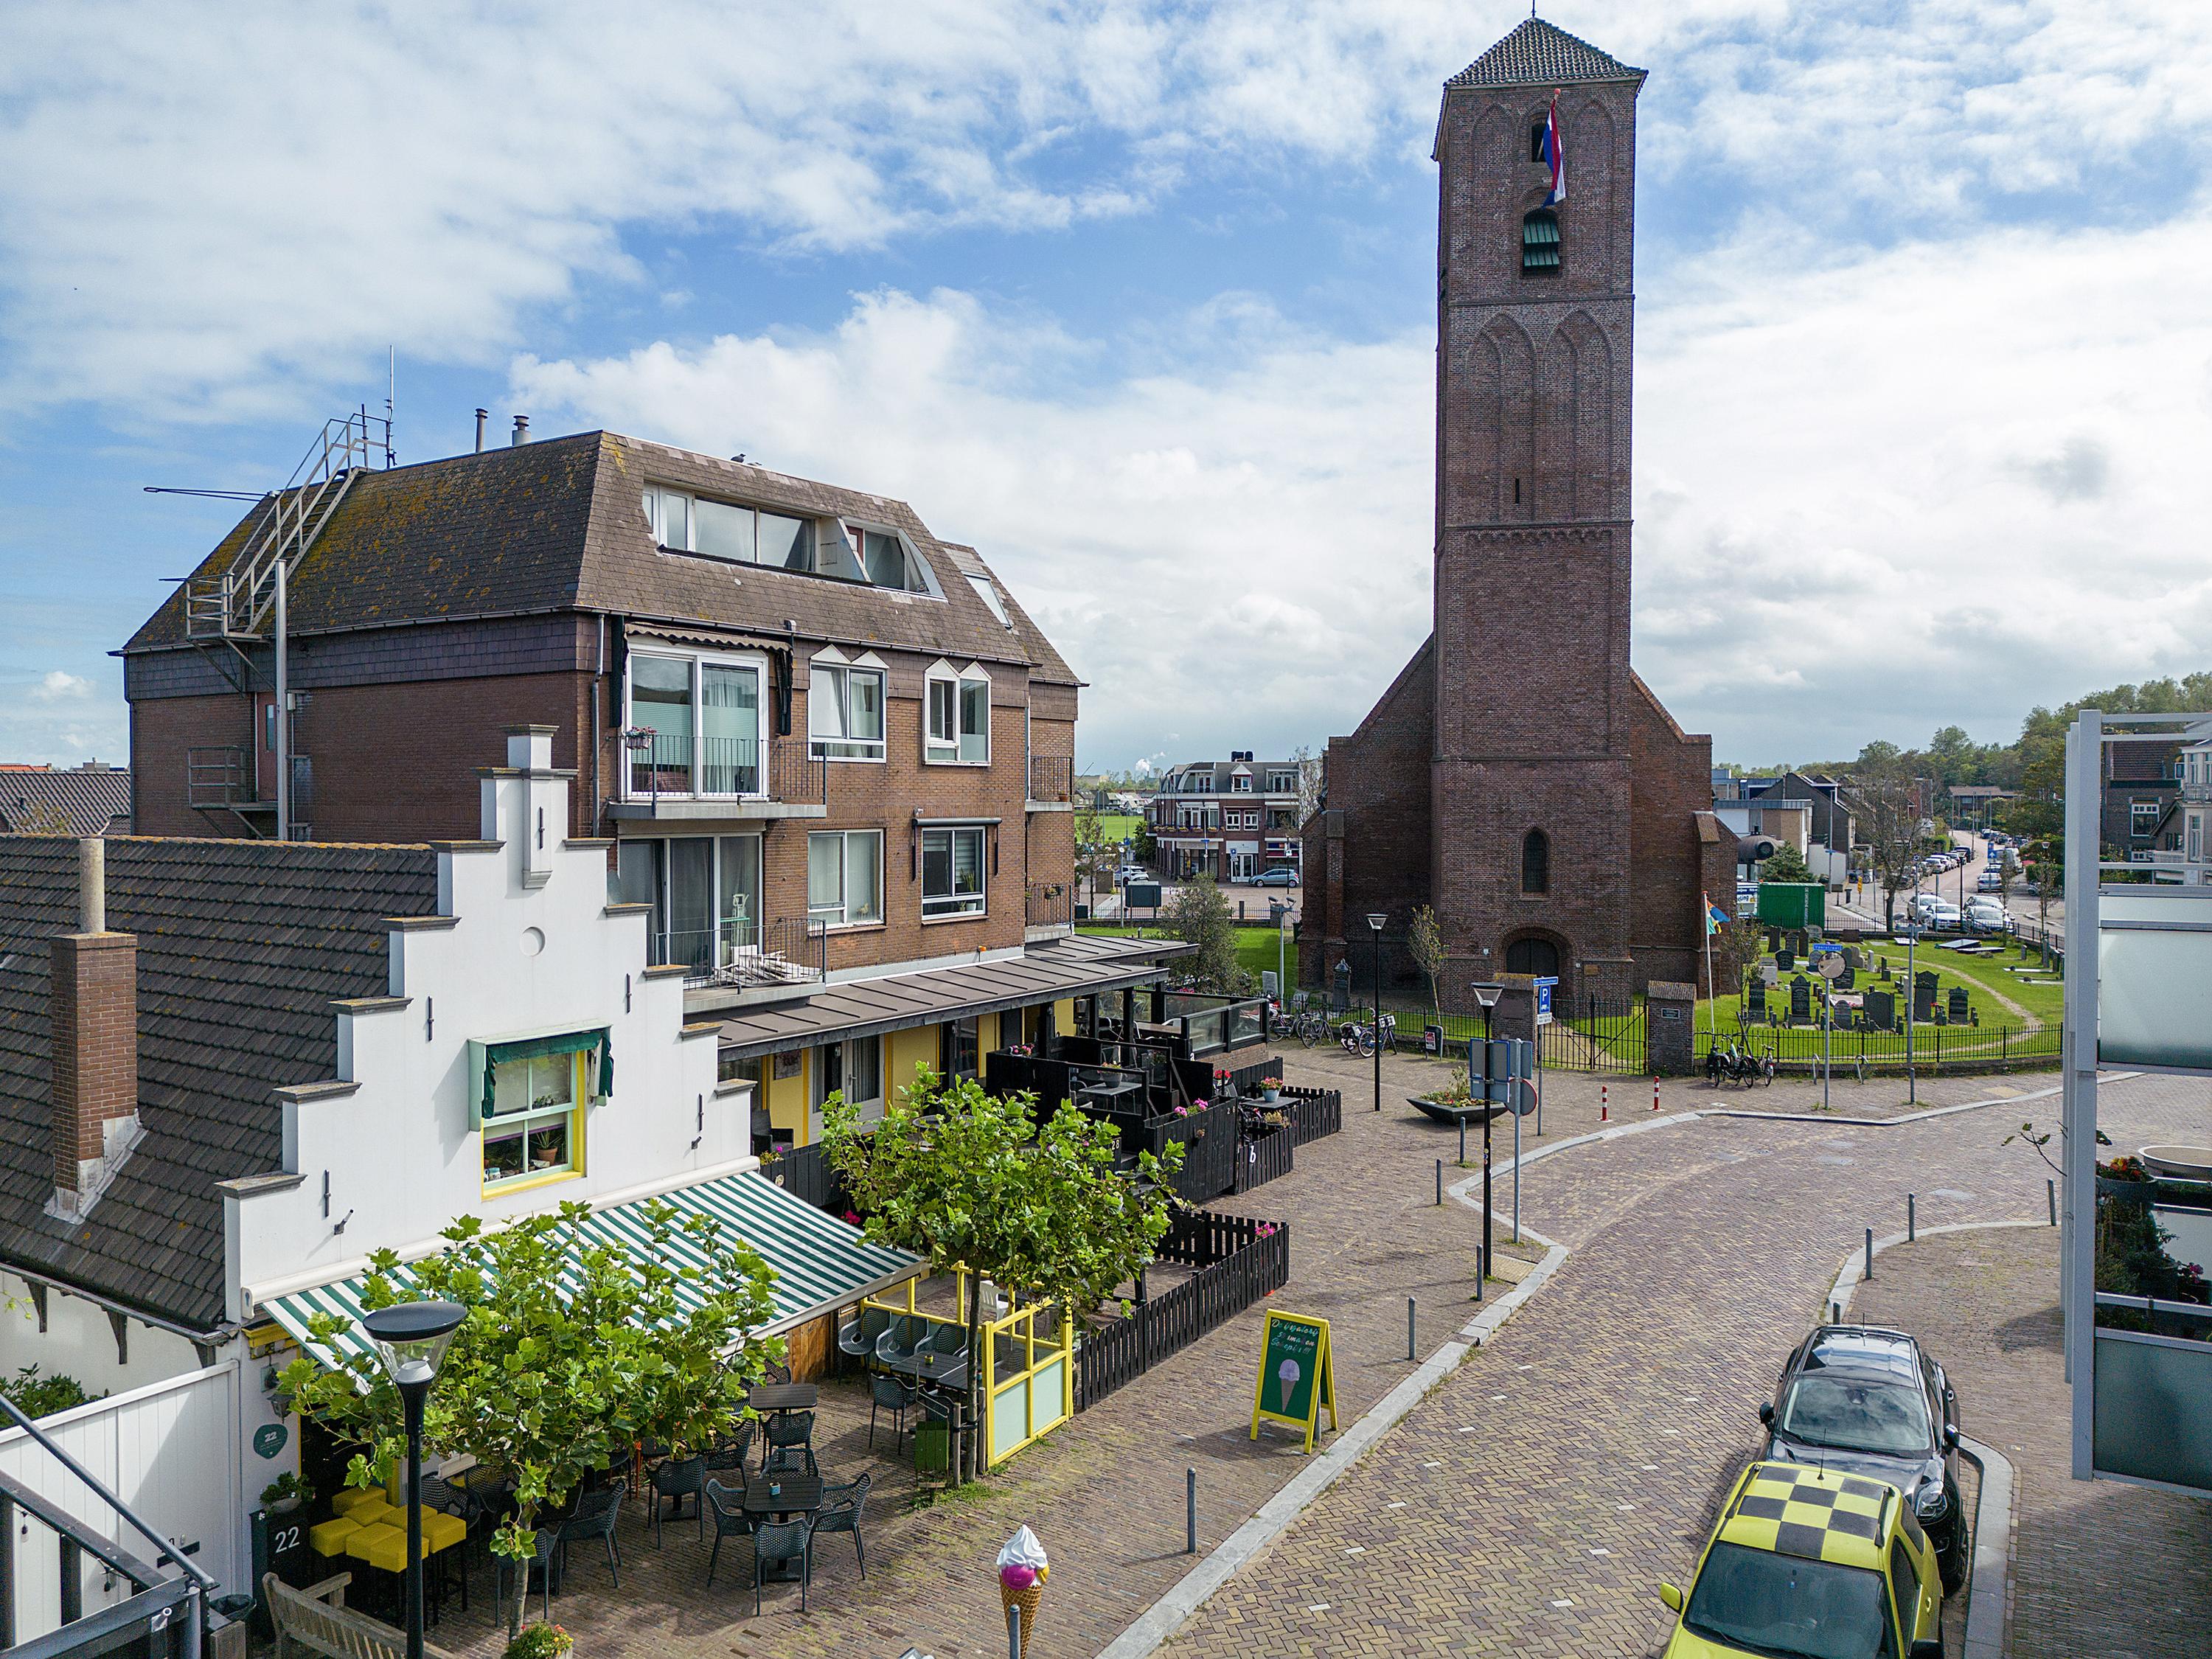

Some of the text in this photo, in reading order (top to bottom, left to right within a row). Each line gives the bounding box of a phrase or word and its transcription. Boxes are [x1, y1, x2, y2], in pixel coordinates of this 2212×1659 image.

[1543, 988, 1548, 1002] P
[1112, 1139, 1120, 1150] 28
[1250, 1146, 1256, 1164] b
[265, 1431, 277, 1443] 22
[275, 1526, 300, 1554] 22
